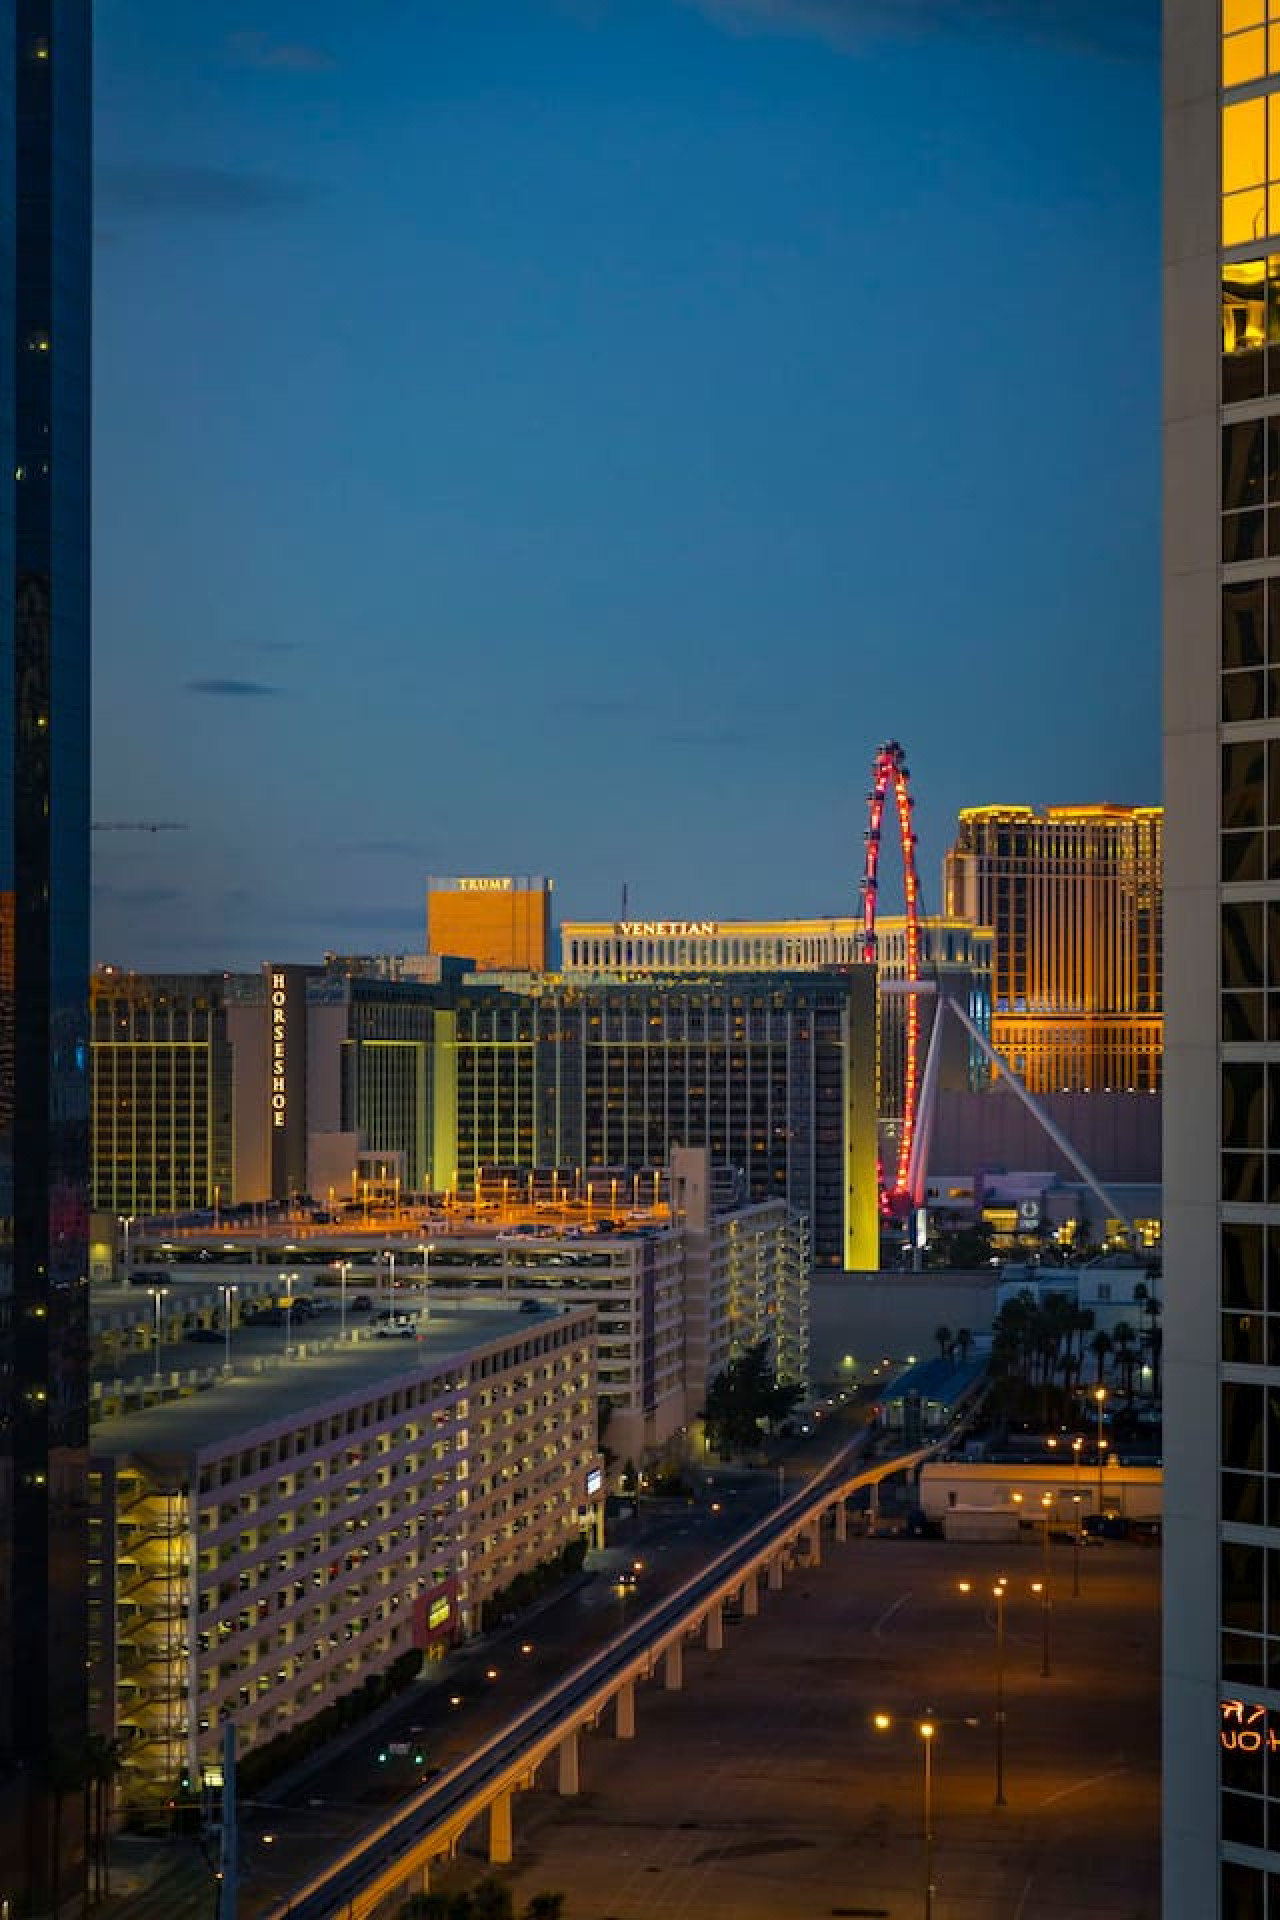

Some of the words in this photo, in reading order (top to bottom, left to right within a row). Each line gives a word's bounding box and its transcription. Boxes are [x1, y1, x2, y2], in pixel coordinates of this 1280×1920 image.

[459, 878, 511, 892] TRUMP
[619, 922, 714, 936] VENETIAN
[272, 973, 287, 1127] HORSESHOE
